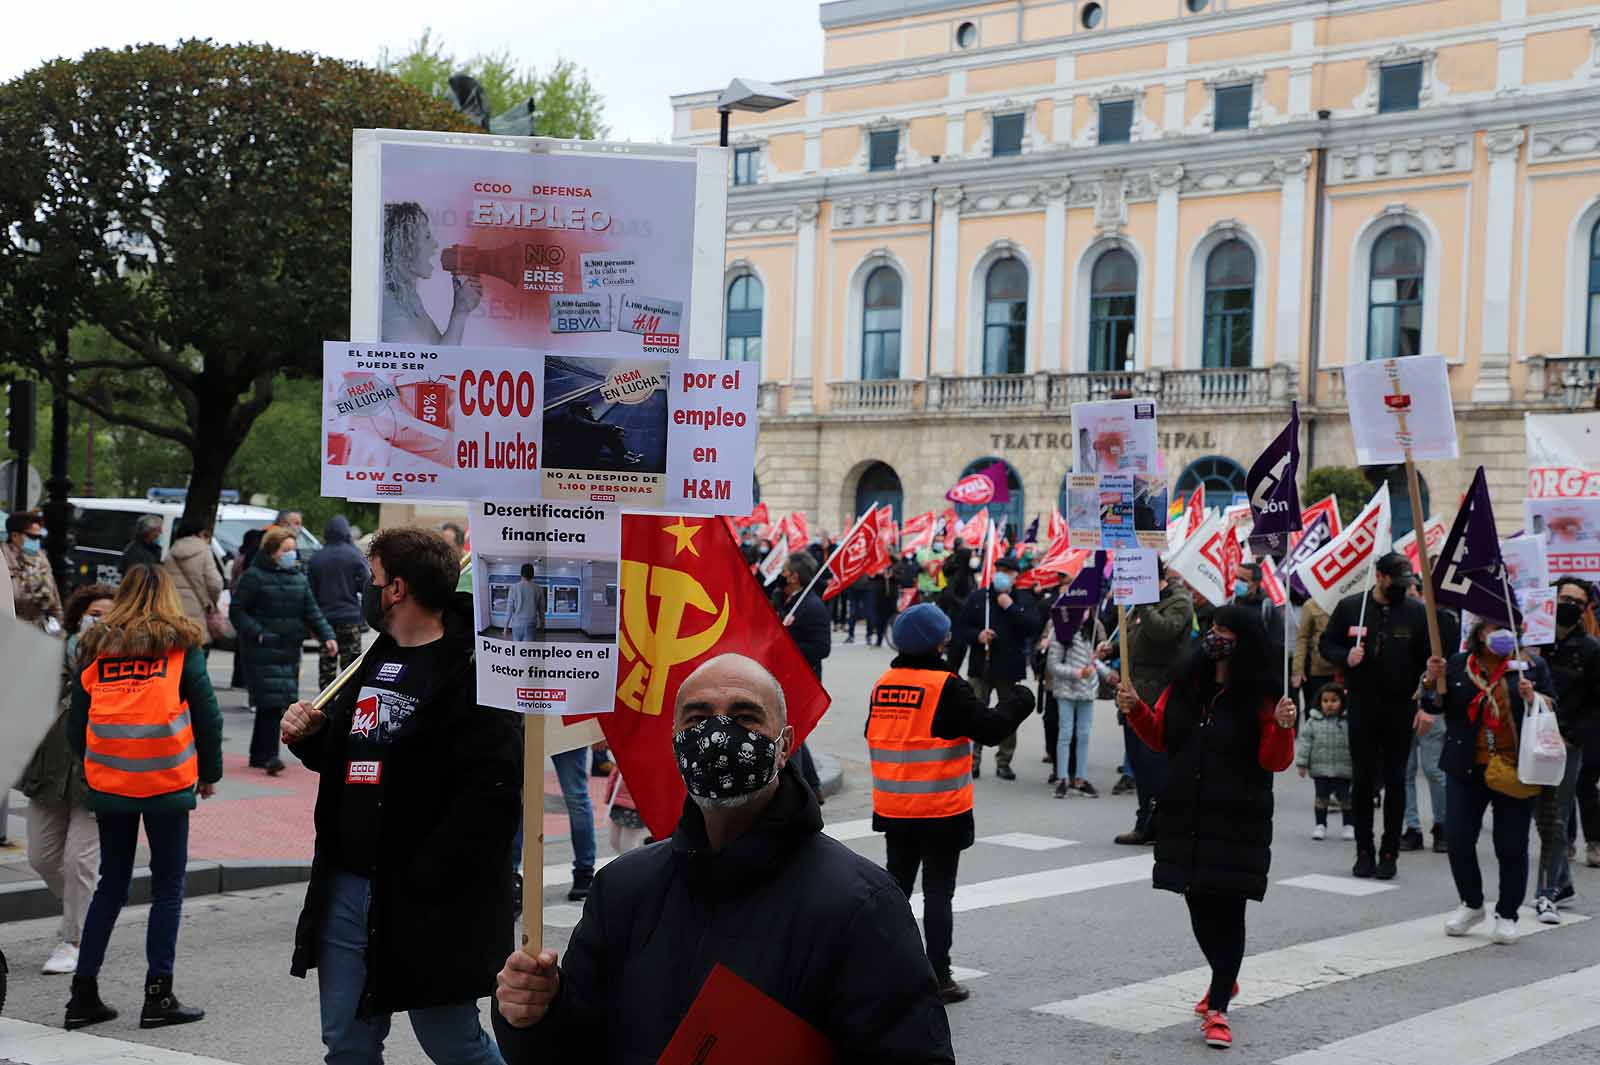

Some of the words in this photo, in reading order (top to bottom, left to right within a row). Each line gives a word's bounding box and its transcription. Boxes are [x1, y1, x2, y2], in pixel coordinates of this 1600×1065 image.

[474, 182, 512, 194] CCOO
[532, 185, 592, 198] DEFENSA
[473, 200, 612, 232] EMPLEO
[524, 243, 565, 266] NO
[523, 270, 564, 284] ERES
[557, 317, 601, 331] BBVA
[645, 335, 678, 345] CCOO
[348, 350, 363, 358] EL
[367, 350, 416, 359] EMPLEO
[420, 352, 438, 360] NO
[643, 346, 679, 354] servicios
[357, 361, 398, 370] PUEDE
[402, 362, 425, 370] SER
[614, 369, 642, 385] H&M
[683, 371, 717, 393] por
[722, 369, 740, 390] el
[346, 381, 376, 397] H&M
[459, 369, 535, 418] CCOO
[604, 389, 620, 401] EN
[621, 375, 660, 396] LUCHA
[336, 402, 354, 414] EN
[357, 388, 396, 408] LUCHA
[423, 393, 438, 423] 50%
[673, 406, 746, 430] empleo
[990, 433, 1072, 449] TEATRO
[457, 439, 478, 469] en
[485, 431, 537, 471] Lucha
[693, 447, 717, 463] en
[345, 471, 386, 482] LOW
[392, 472, 438, 483] COST
[547, 471, 563, 479] NO
[568, 472, 583, 480] AL
[586, 473, 638, 483] DESPIDO
[643, 475, 658, 484] DE
[558, 483, 586, 491] 1.100
[590, 484, 653, 494] PERSONAS
[683, 479, 731, 500] H&M
[484, 502, 605, 520] Desertificación
[501, 526, 586, 543] financiera
[483, 640, 502, 654] Por
[504, 645, 516, 657] el
[519, 647, 572, 661] empleo
[576, 649, 593, 659] en
[597, 647, 610, 659] el
[102, 659, 164, 679] CCOO
[491, 663, 525, 678] sector
[528, 665, 600, 680] financiero
[518, 690, 551, 699] CCOO
[877, 689, 921, 705] CCOO
[516, 701, 552, 709] servicios
